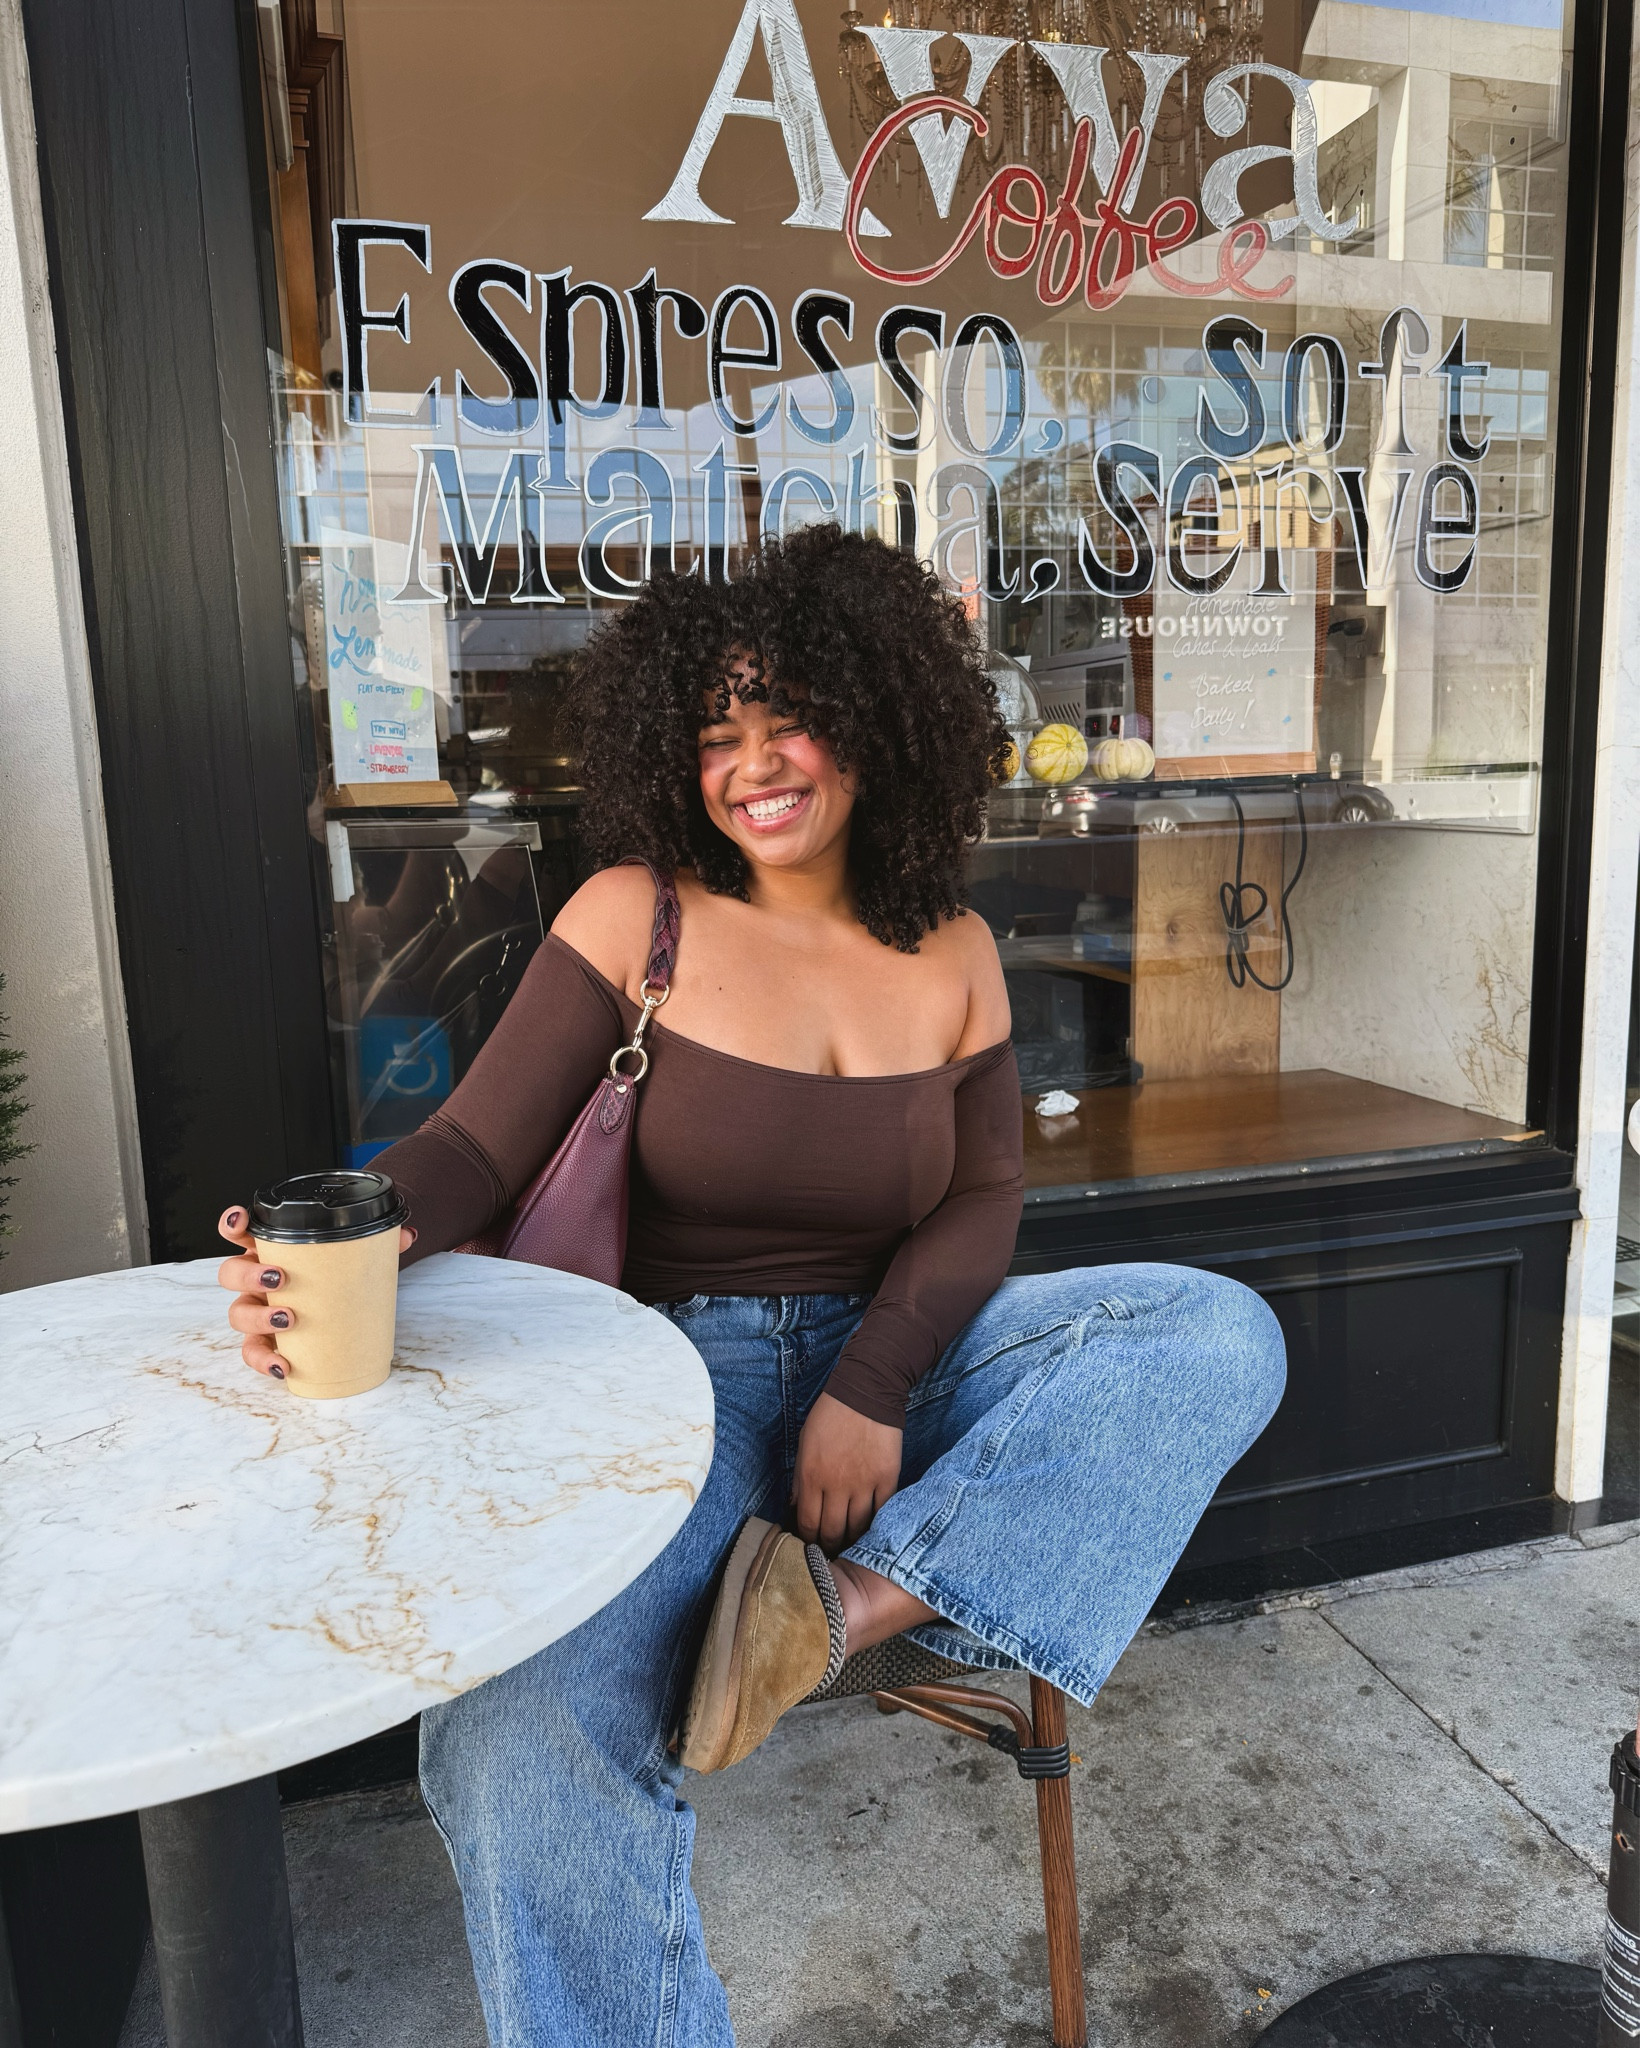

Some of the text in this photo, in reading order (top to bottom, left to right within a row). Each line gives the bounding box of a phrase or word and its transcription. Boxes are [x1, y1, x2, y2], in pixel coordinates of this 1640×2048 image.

[847, 96, 1297, 311] Coffee
[332, 218, 1491, 490] Espresso, soft
[385, 436, 1061, 604] Matcha,
[1185, 597, 1279, 618] Homemade
[329, 624, 422, 676] Lemnade
[1173, 631, 1218, 659] Cakes
[1196, 672, 1255, 698] Baked
